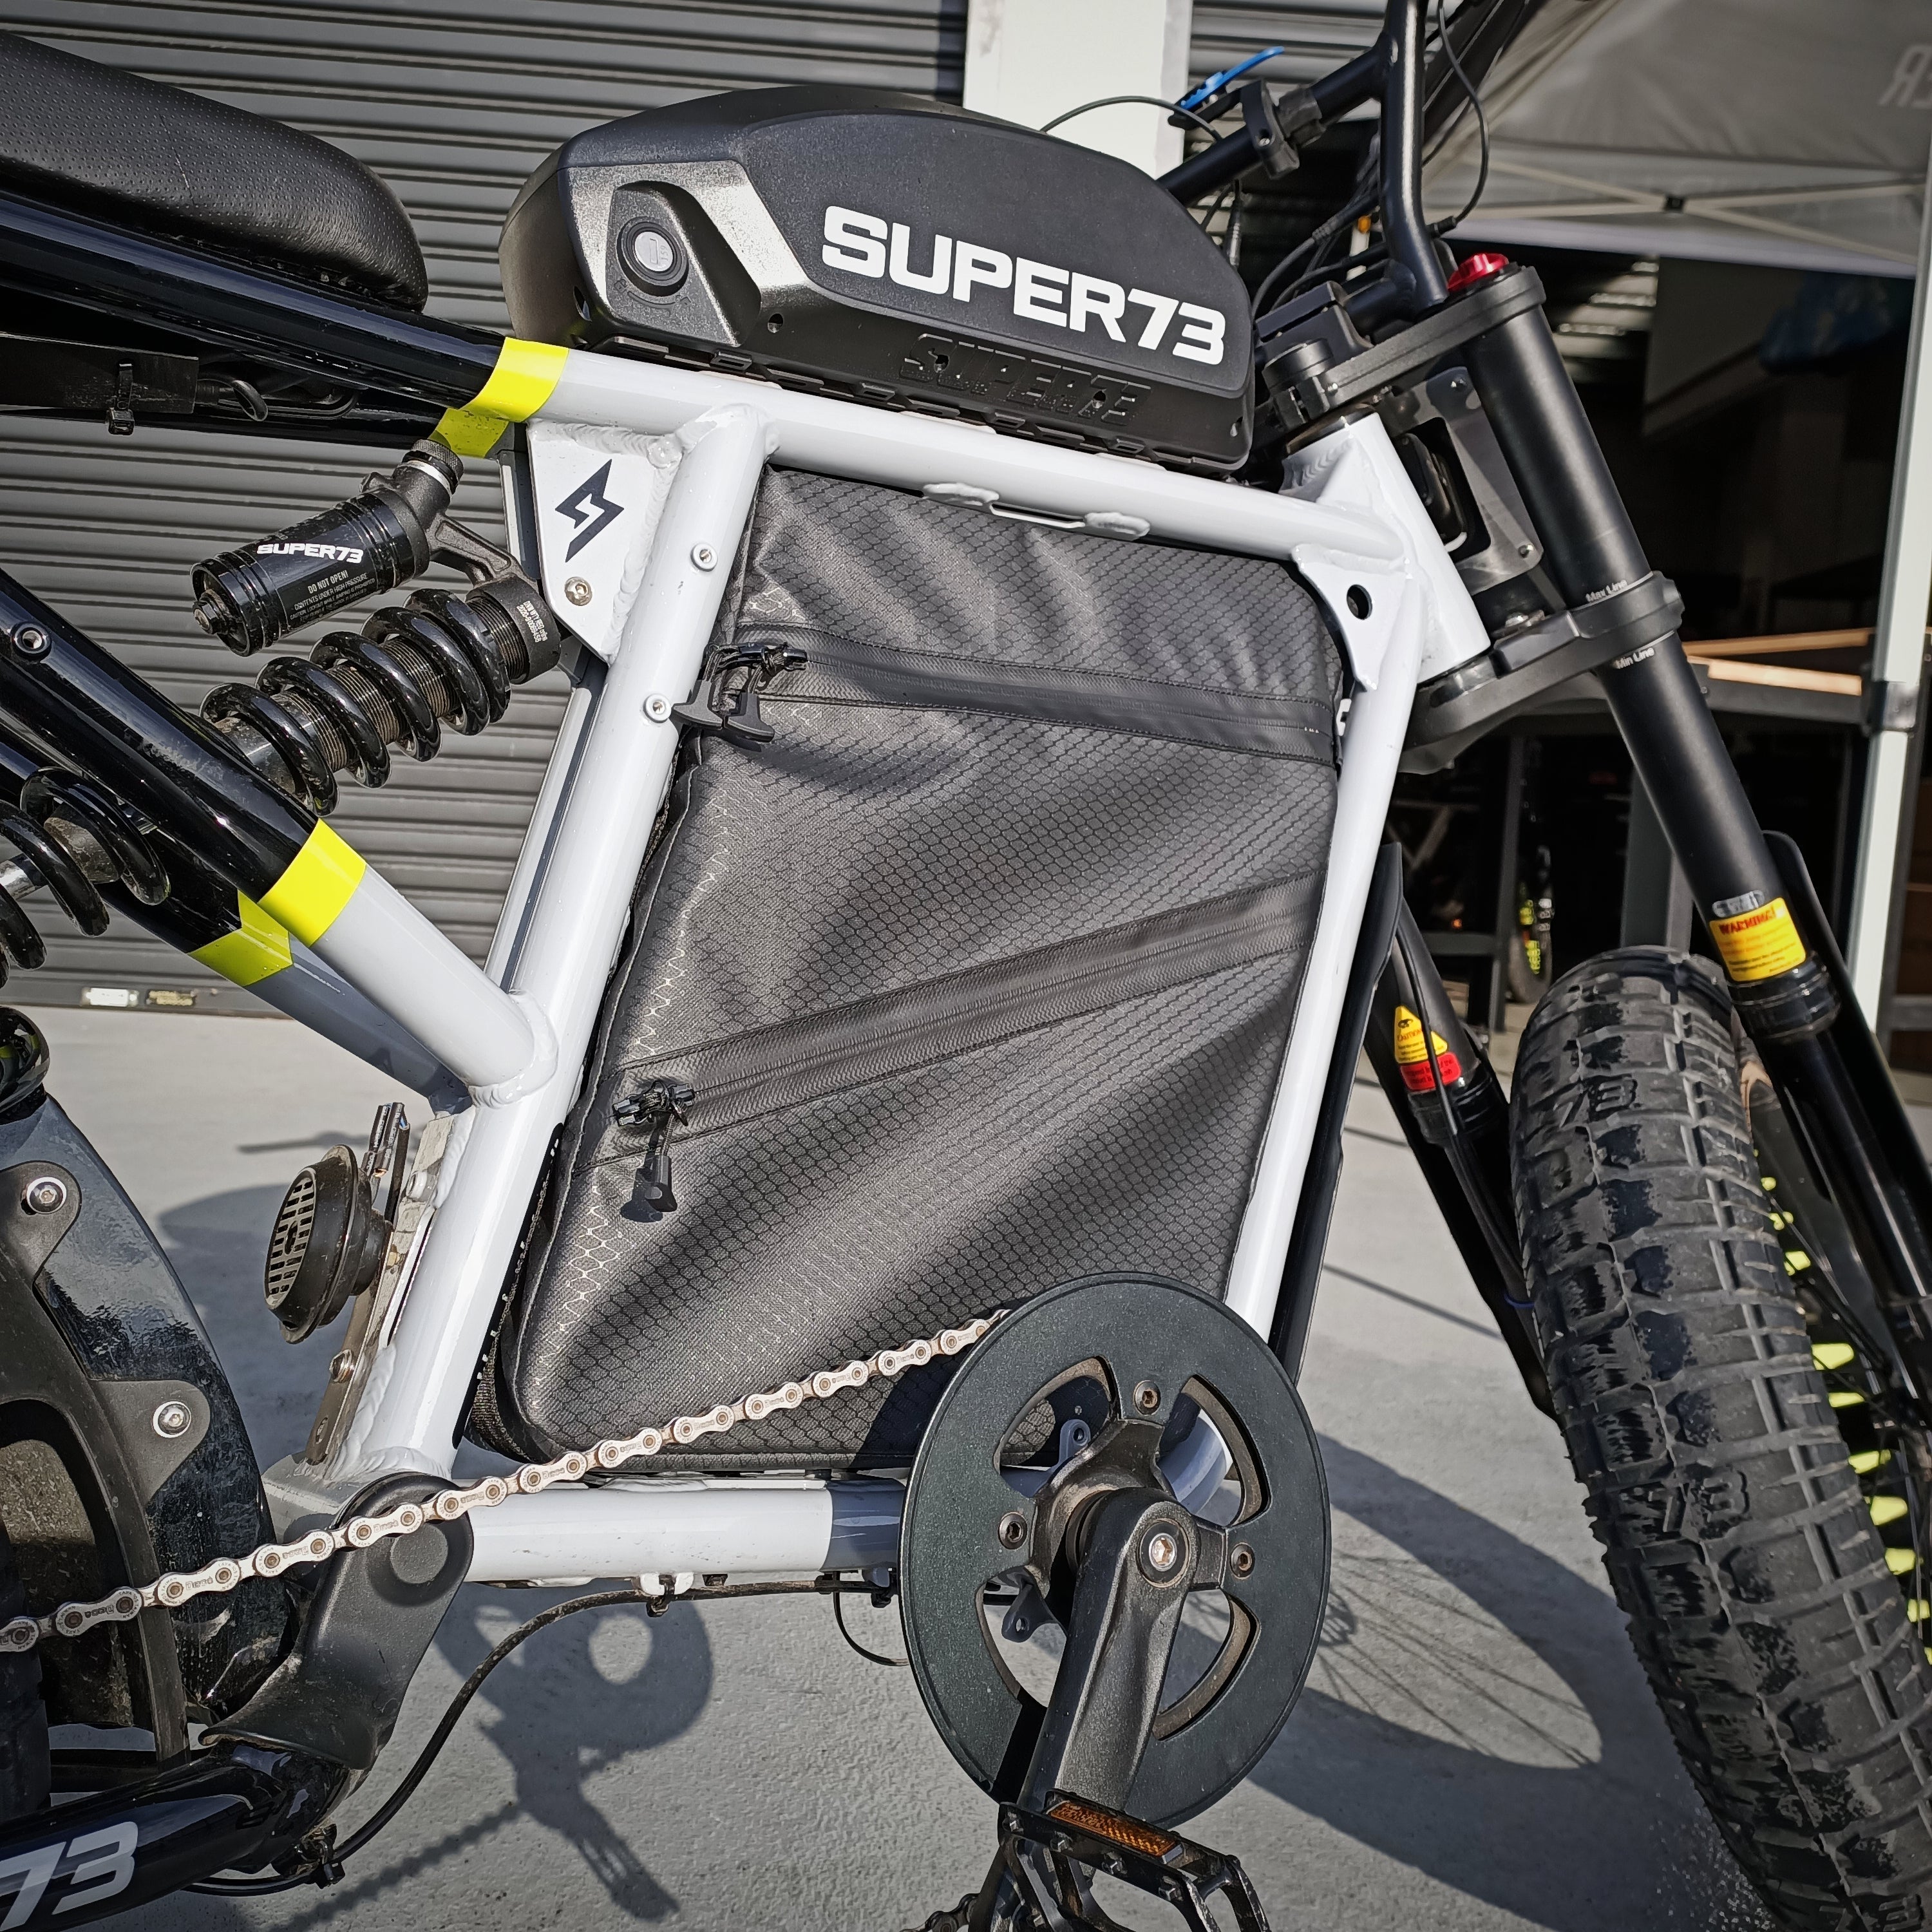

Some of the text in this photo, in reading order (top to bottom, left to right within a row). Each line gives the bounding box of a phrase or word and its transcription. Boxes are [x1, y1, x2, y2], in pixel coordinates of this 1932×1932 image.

[822, 205, 1226, 365] SUPER73
[256, 542, 363, 564] SUPER73
[294, 573, 368, 611] CONTENTS UNDER HIGH PRESSURE
[307, 570, 348, 594] DO NOT OPEN!
[1633, 647, 1654, 662] Line
